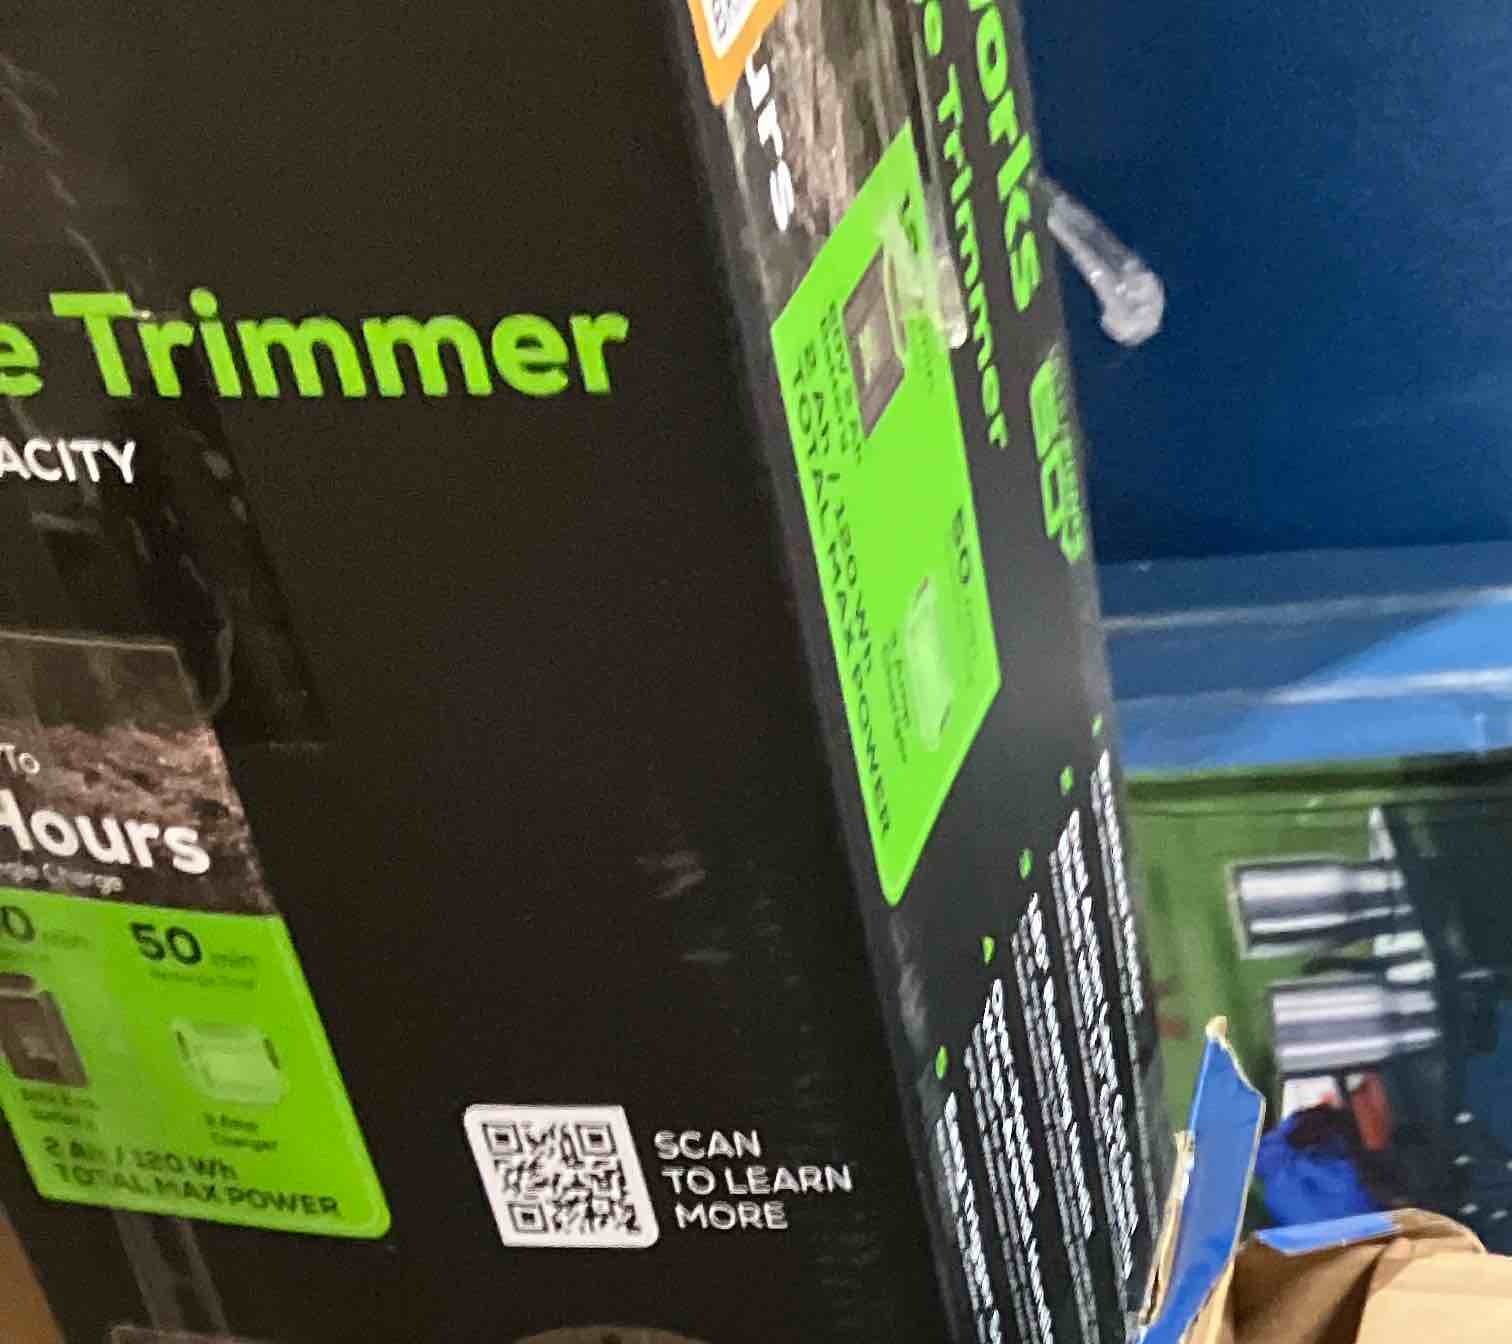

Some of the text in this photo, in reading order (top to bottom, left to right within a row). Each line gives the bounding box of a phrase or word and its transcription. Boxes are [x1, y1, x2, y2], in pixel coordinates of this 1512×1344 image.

[937, 63, 1008, 449] Trimmer
[50, 288, 628, 398] Trimmer
[129, 926, 204, 967] 50
[653, 1129, 761, 1161] SCAN
[661, 1163, 854, 1196] TO LEARN
[223, 1184, 344, 1220] POWER
[674, 1200, 789, 1231] MORE
